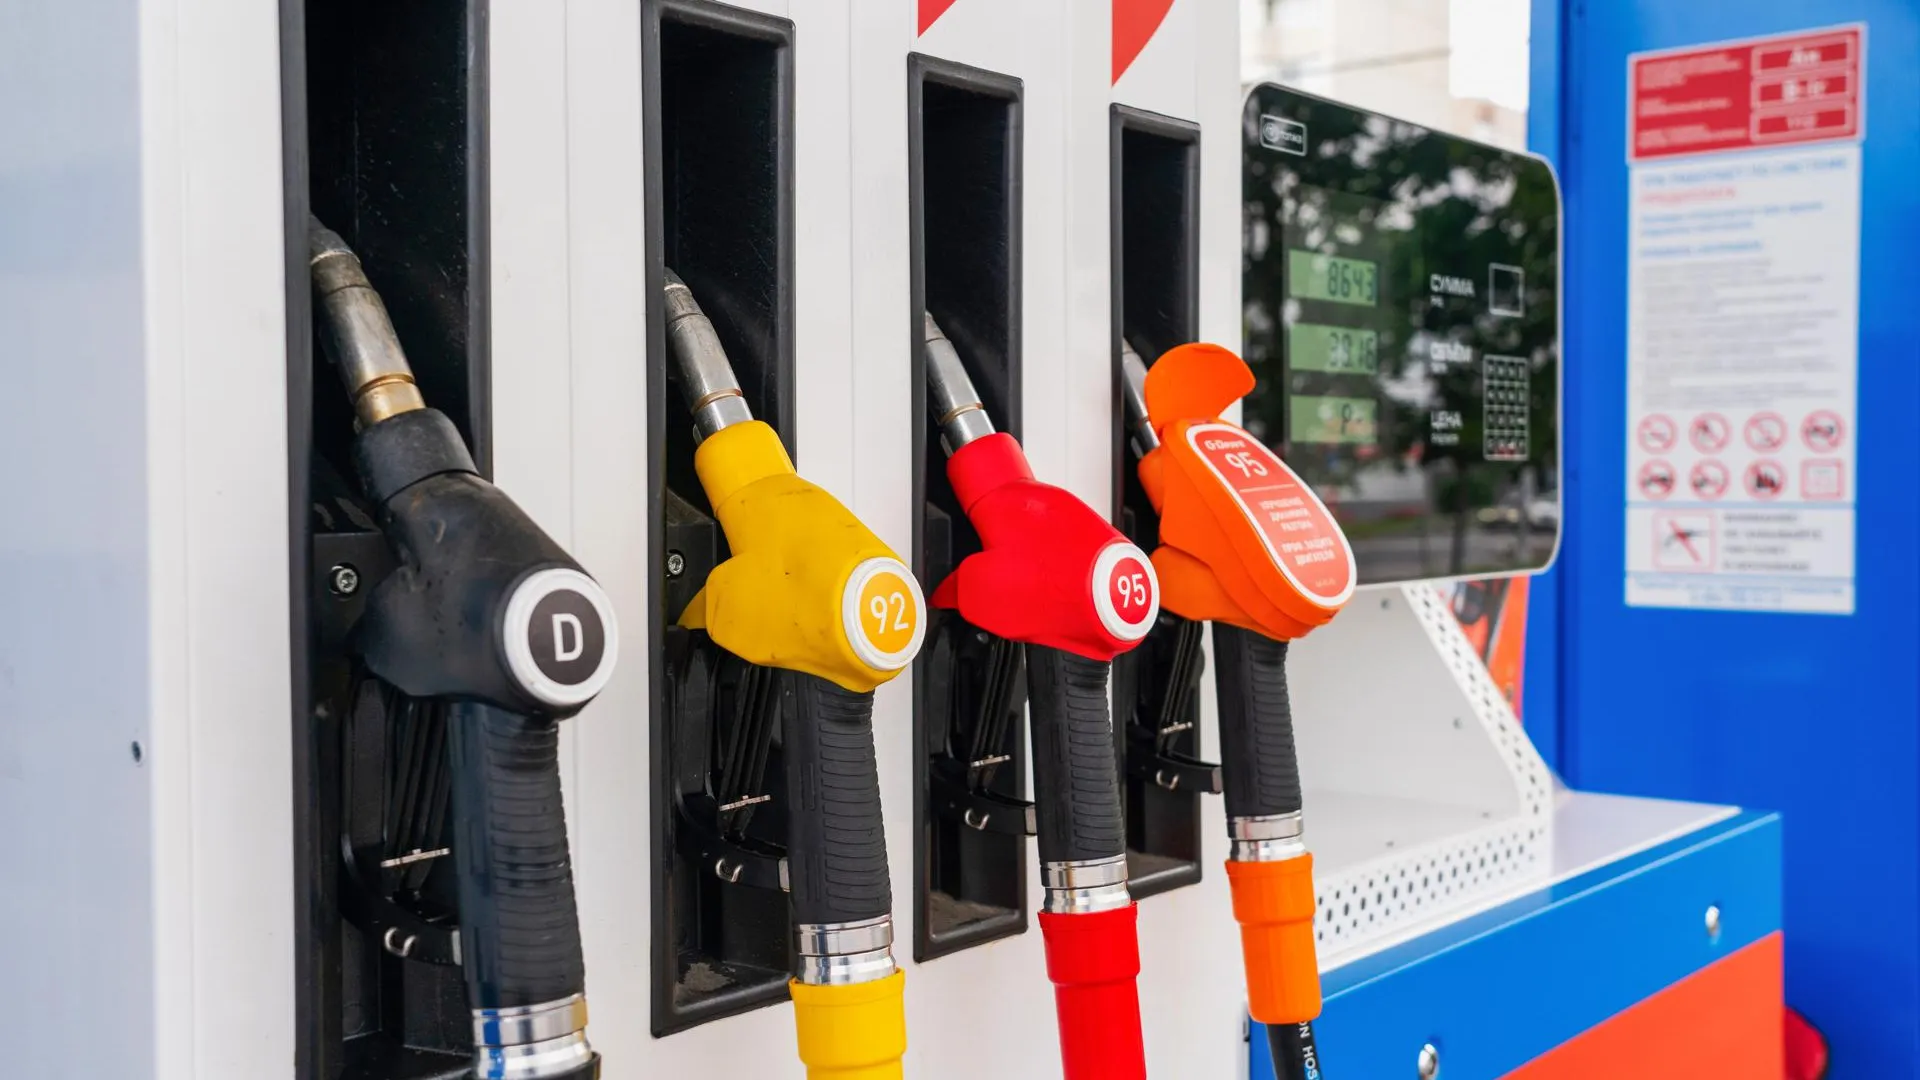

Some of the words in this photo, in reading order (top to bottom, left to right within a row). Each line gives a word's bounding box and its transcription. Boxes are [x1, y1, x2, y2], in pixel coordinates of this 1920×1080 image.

[1430, 273, 1475, 297] СУММА
[1431, 411, 1463, 431] ЦЕНА
[1225, 452, 1268, 478] 95
[1117, 573, 1147, 608] 95
[871, 591, 909, 634] 92
[552, 613, 584, 662] D
[1302, 1045, 1319, 1080] HOS
